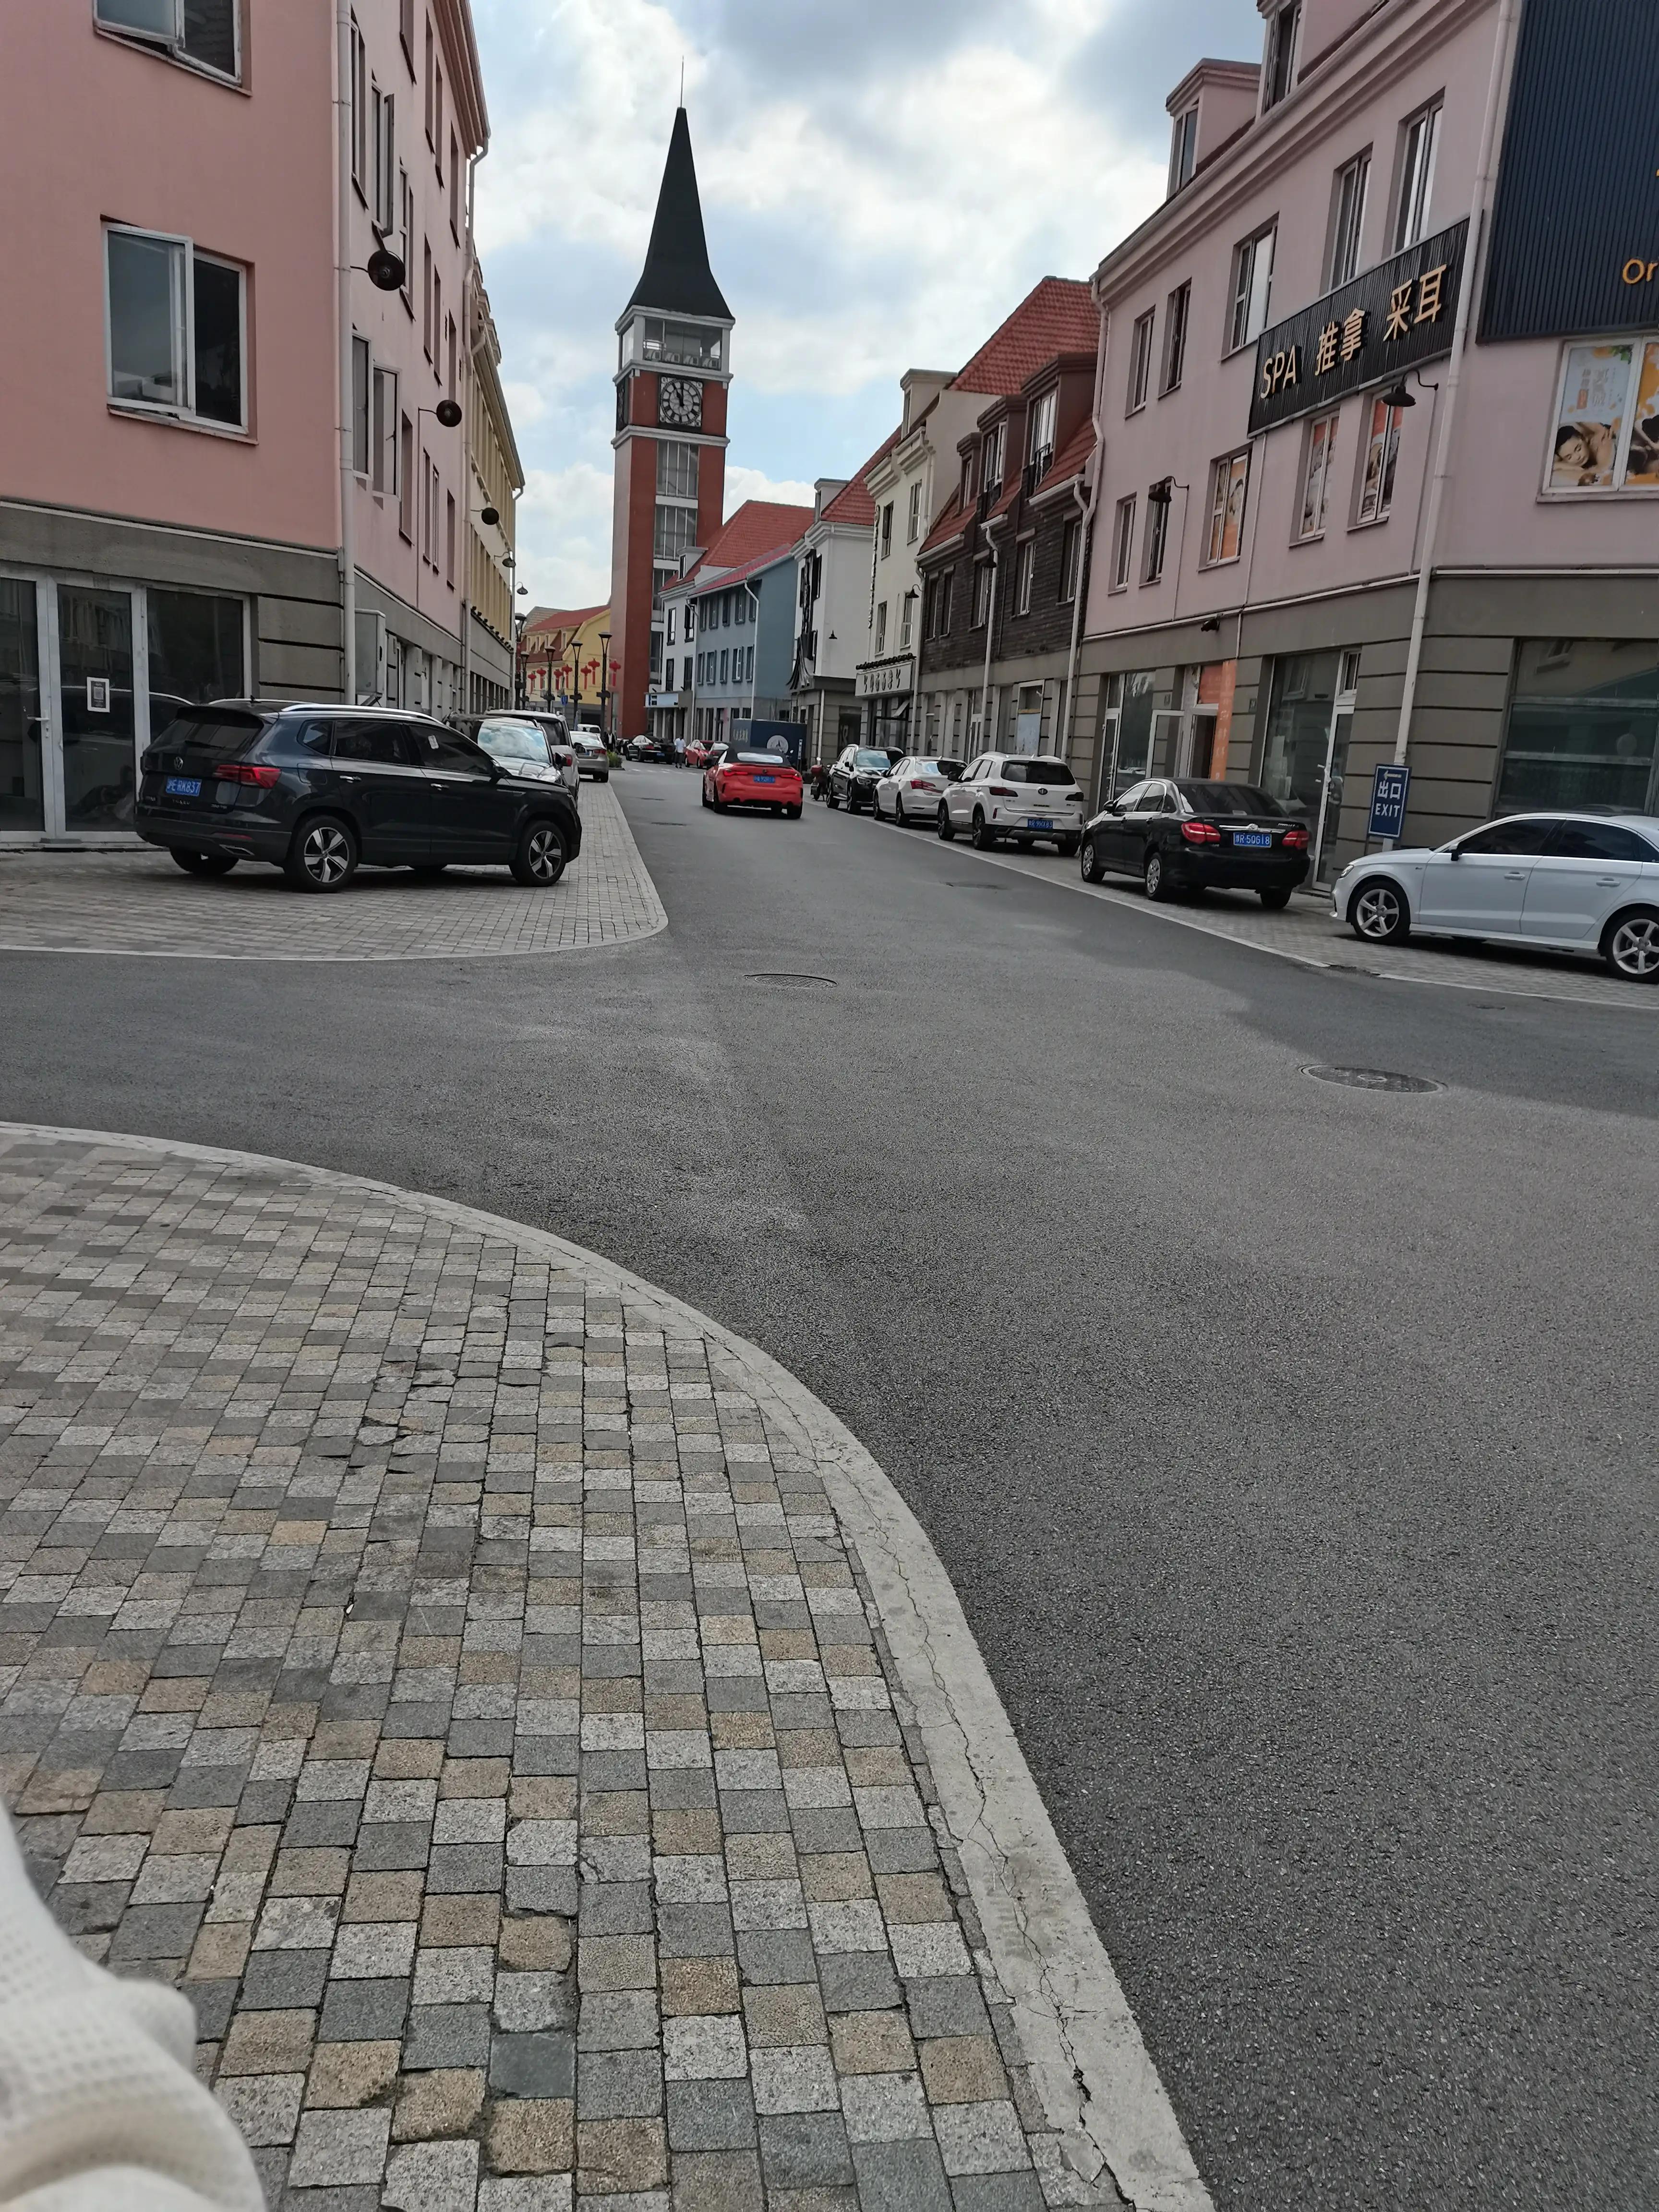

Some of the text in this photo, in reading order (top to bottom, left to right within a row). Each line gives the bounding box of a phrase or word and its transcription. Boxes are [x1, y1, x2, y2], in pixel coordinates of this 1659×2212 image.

[1261, 264, 1447, 399] SPA 推拿 采耳
[1377, 780, 1402, 800] 出口
[1375, 803, 1401, 817] EXIT
